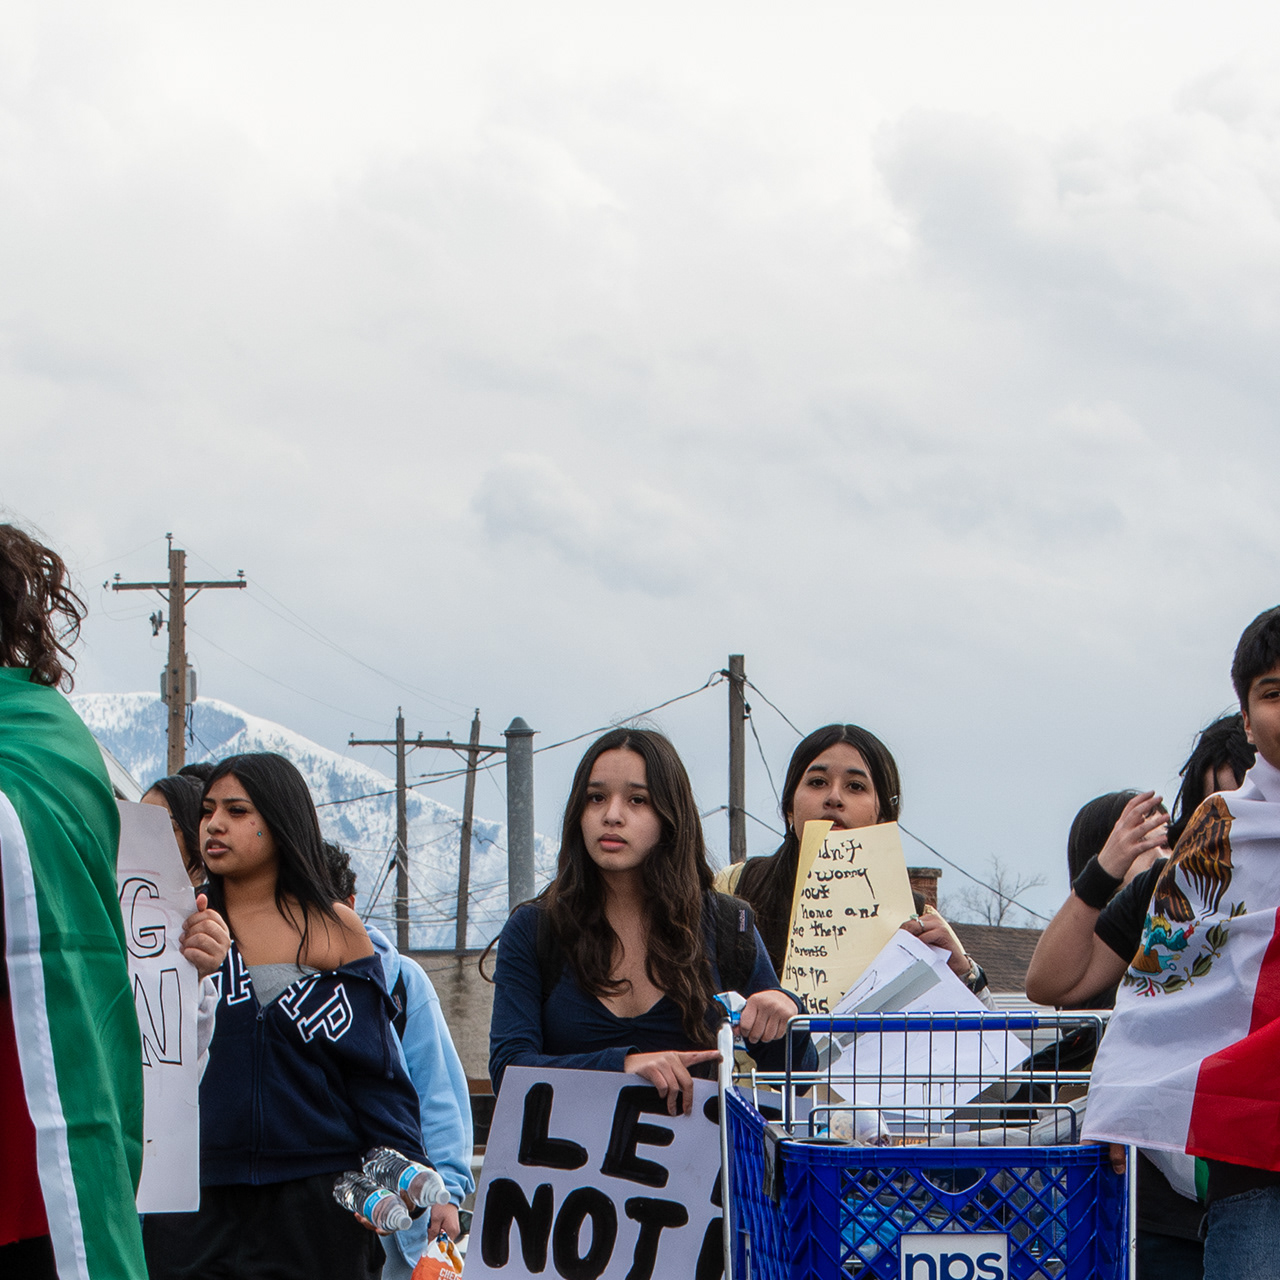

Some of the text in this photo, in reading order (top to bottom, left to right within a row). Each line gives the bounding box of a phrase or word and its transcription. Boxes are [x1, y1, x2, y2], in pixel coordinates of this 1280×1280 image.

[815, 868, 876, 899] worry
[801, 904, 880, 919] home and
